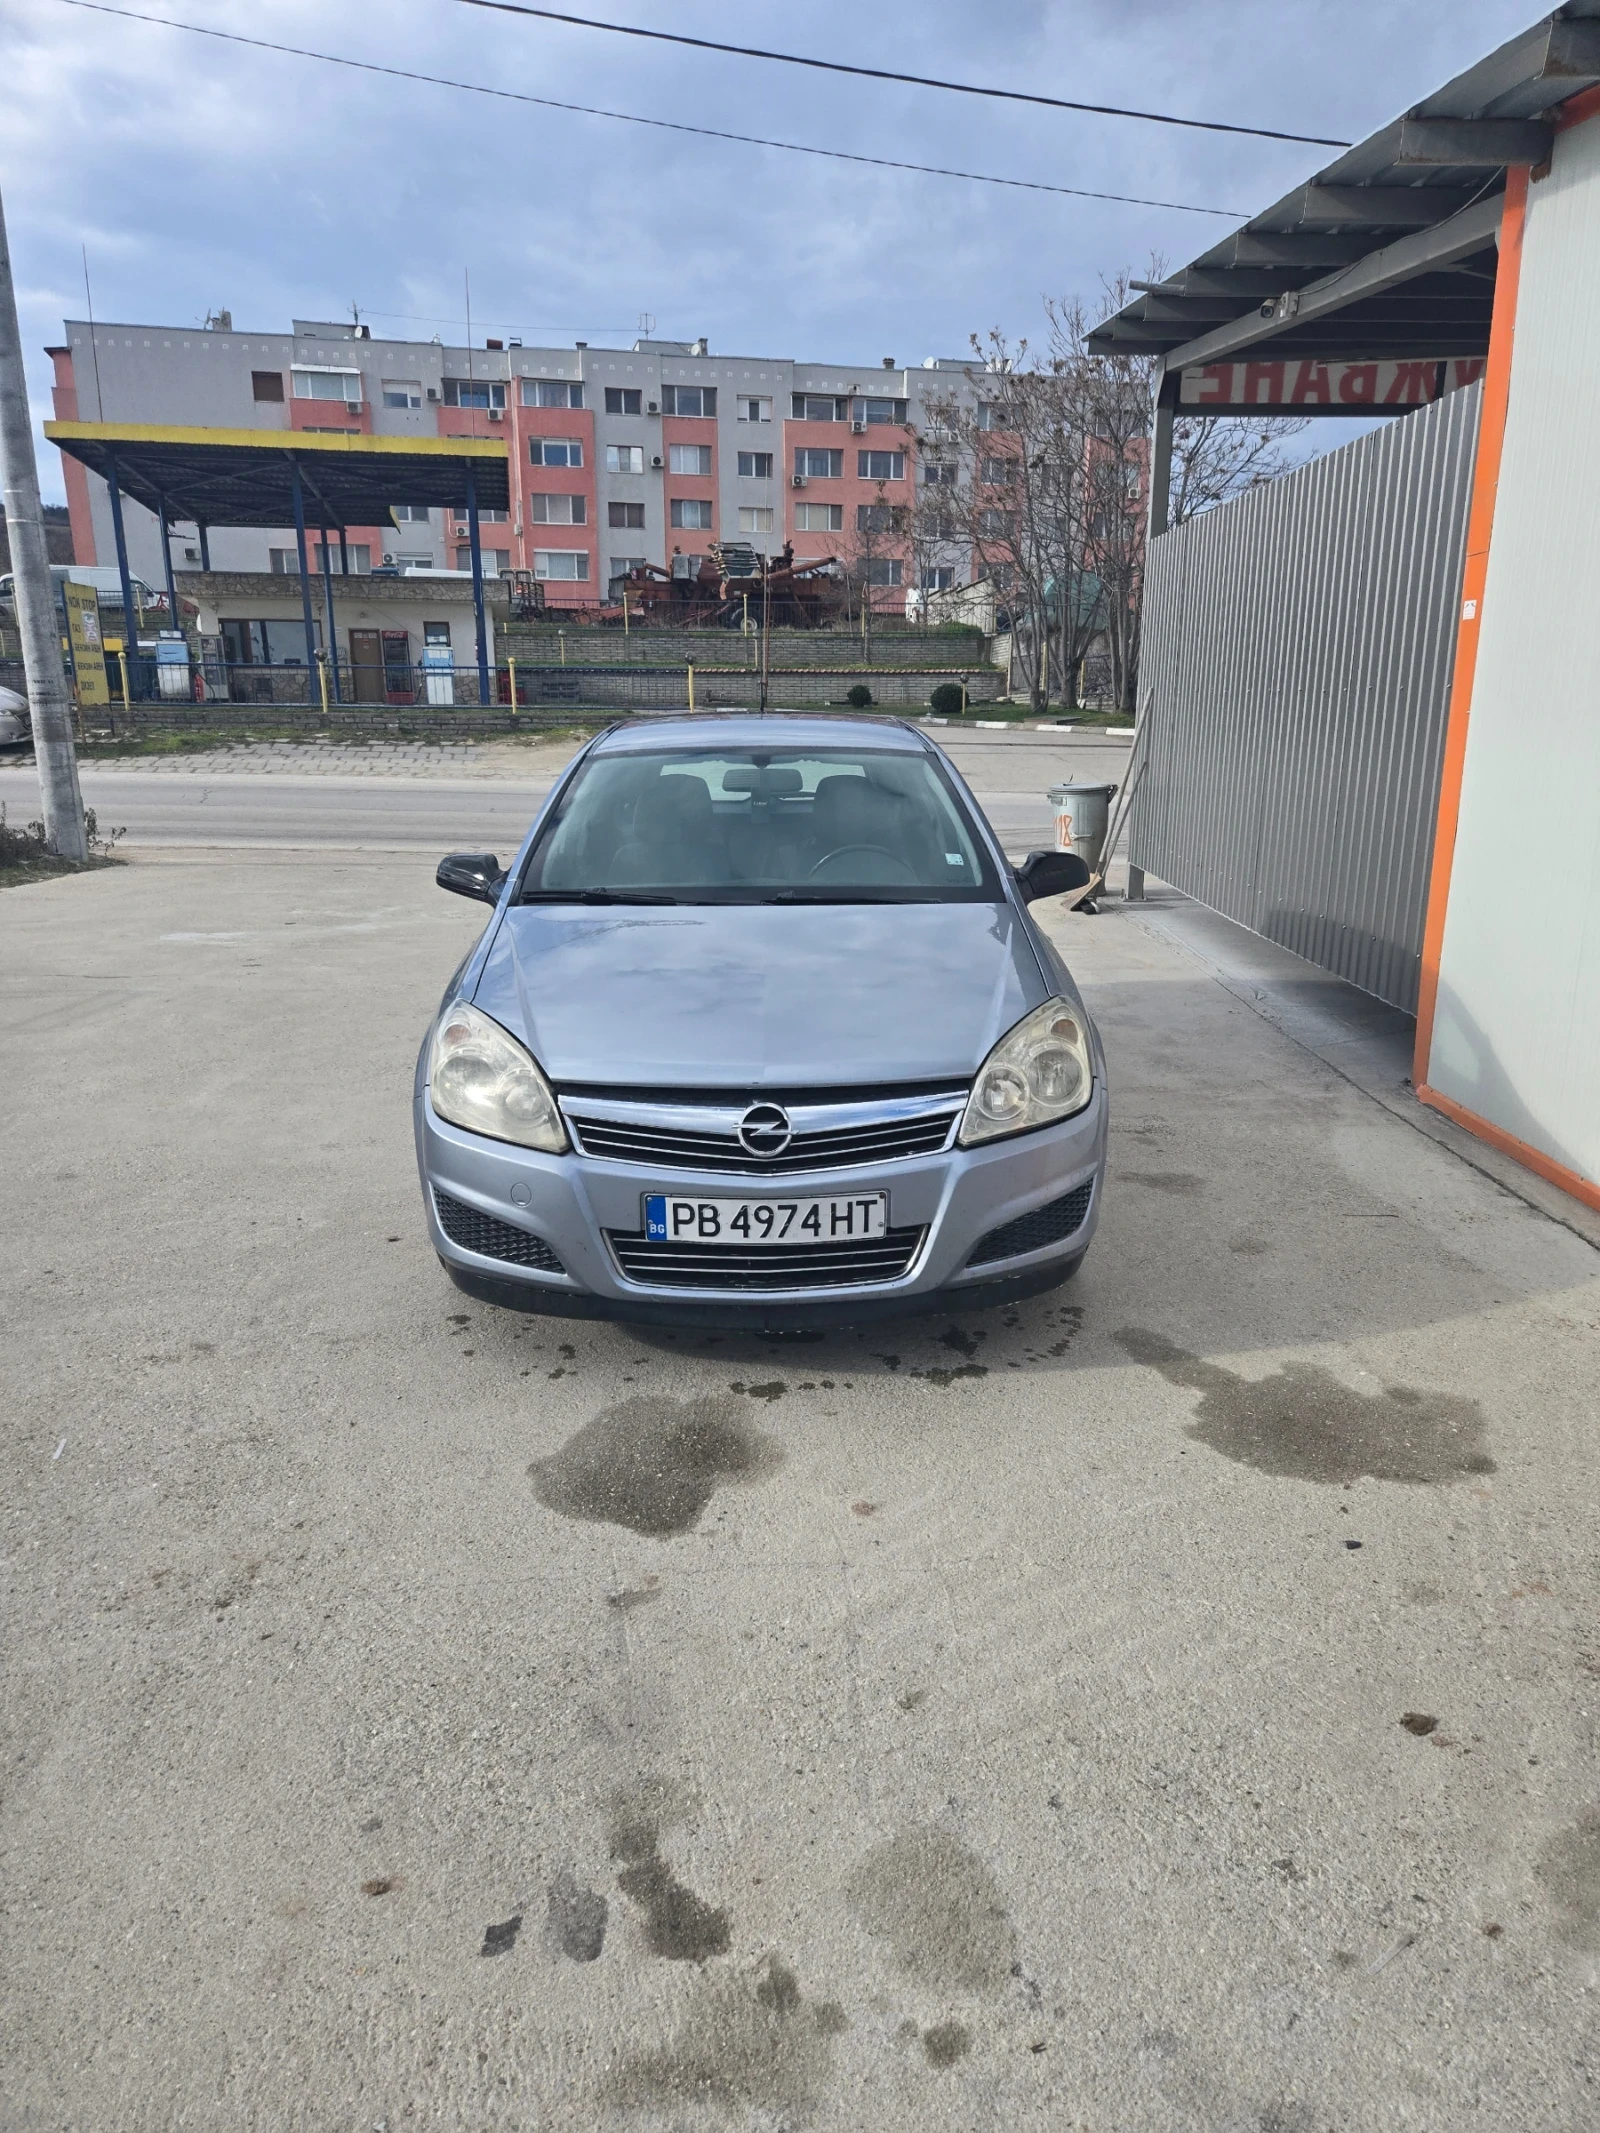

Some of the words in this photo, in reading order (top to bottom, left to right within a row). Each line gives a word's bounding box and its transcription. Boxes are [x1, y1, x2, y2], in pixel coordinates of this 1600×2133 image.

[68, 596, 80, 609] NON
[82, 599, 96, 610] STOP
[72, 623, 81, 633] ГАЗ
[672, 1202, 721, 1238] PB
[730, 1203, 821, 1239] 4974
[830, 1199, 877, 1236] HT
[650, 1223, 665, 1234] BG
